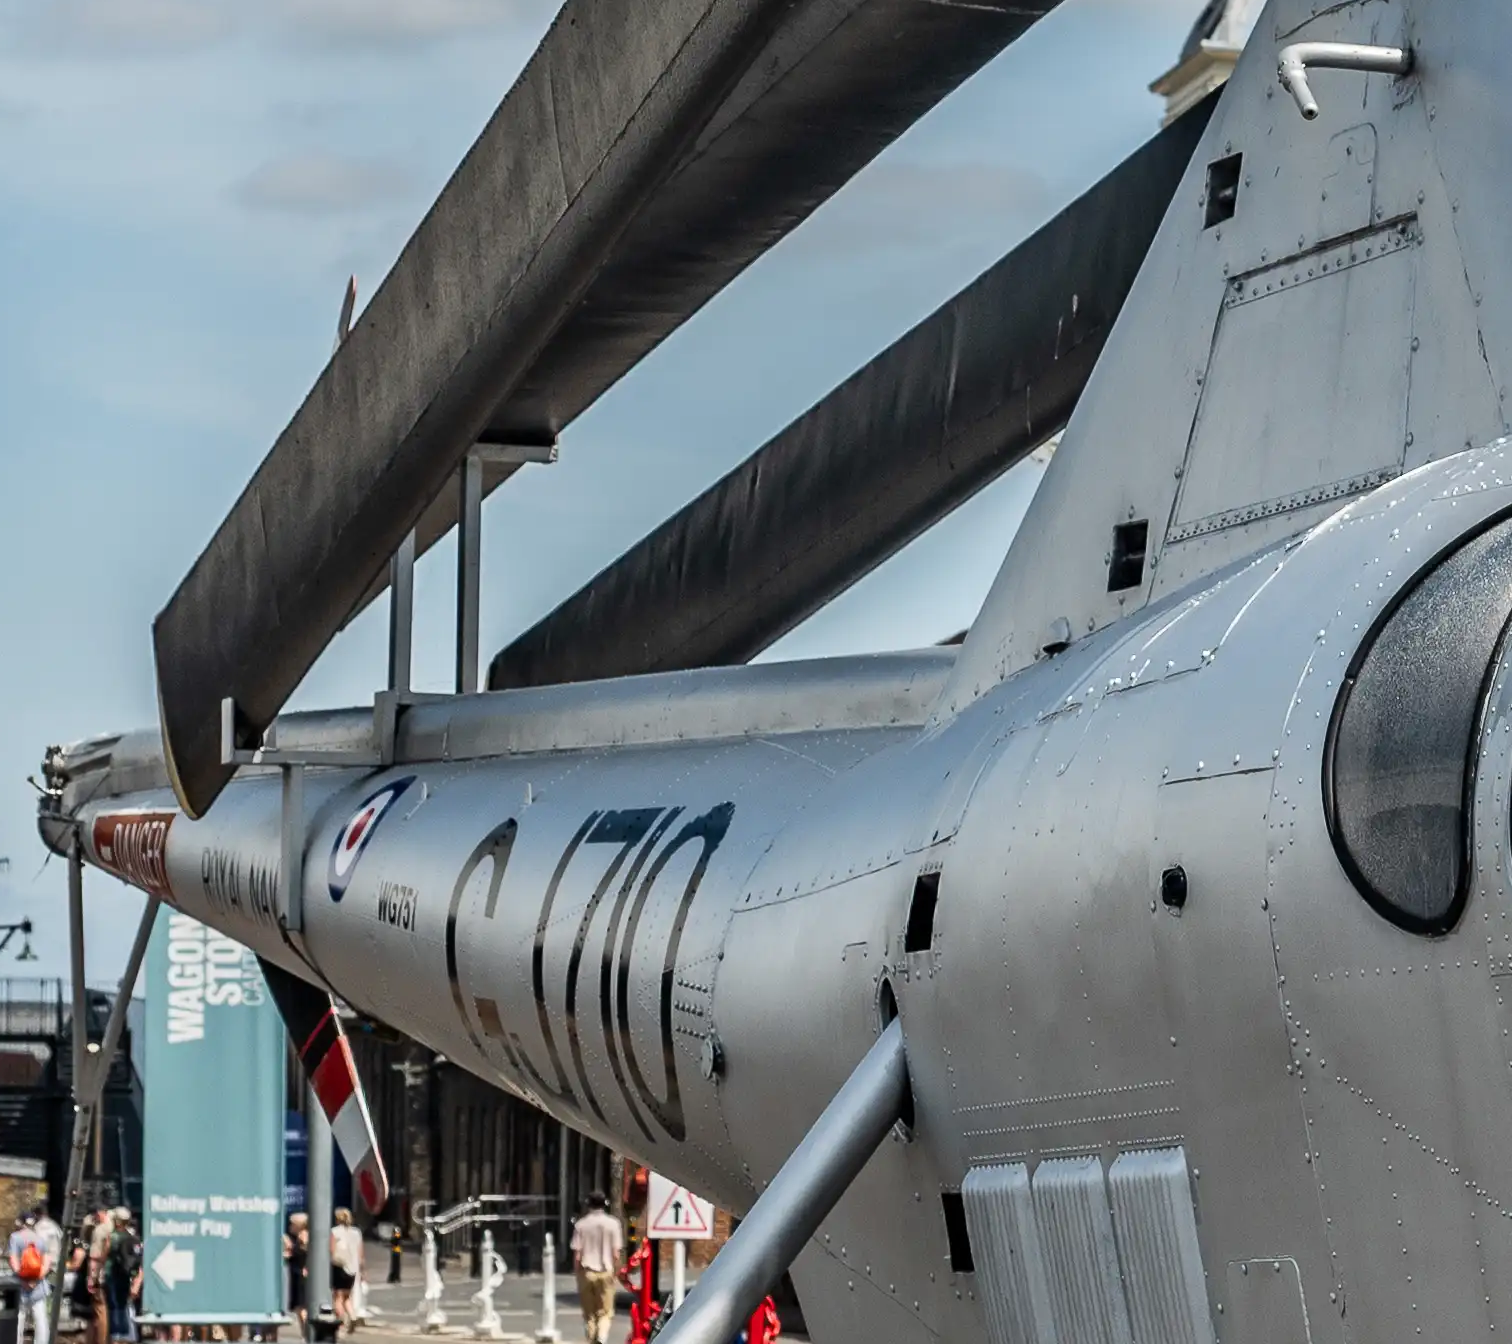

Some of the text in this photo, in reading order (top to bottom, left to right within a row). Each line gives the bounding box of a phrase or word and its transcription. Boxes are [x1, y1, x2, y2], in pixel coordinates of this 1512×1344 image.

[113, 820, 170, 894] DANGER
[377, 878, 419, 932] WG751
[167, 914, 205, 1044] WAGON
[150, 1194, 207, 1215] Railway
[209, 1194, 278, 1215] Workshop
[150, 1219, 232, 1239] Indoor Play
